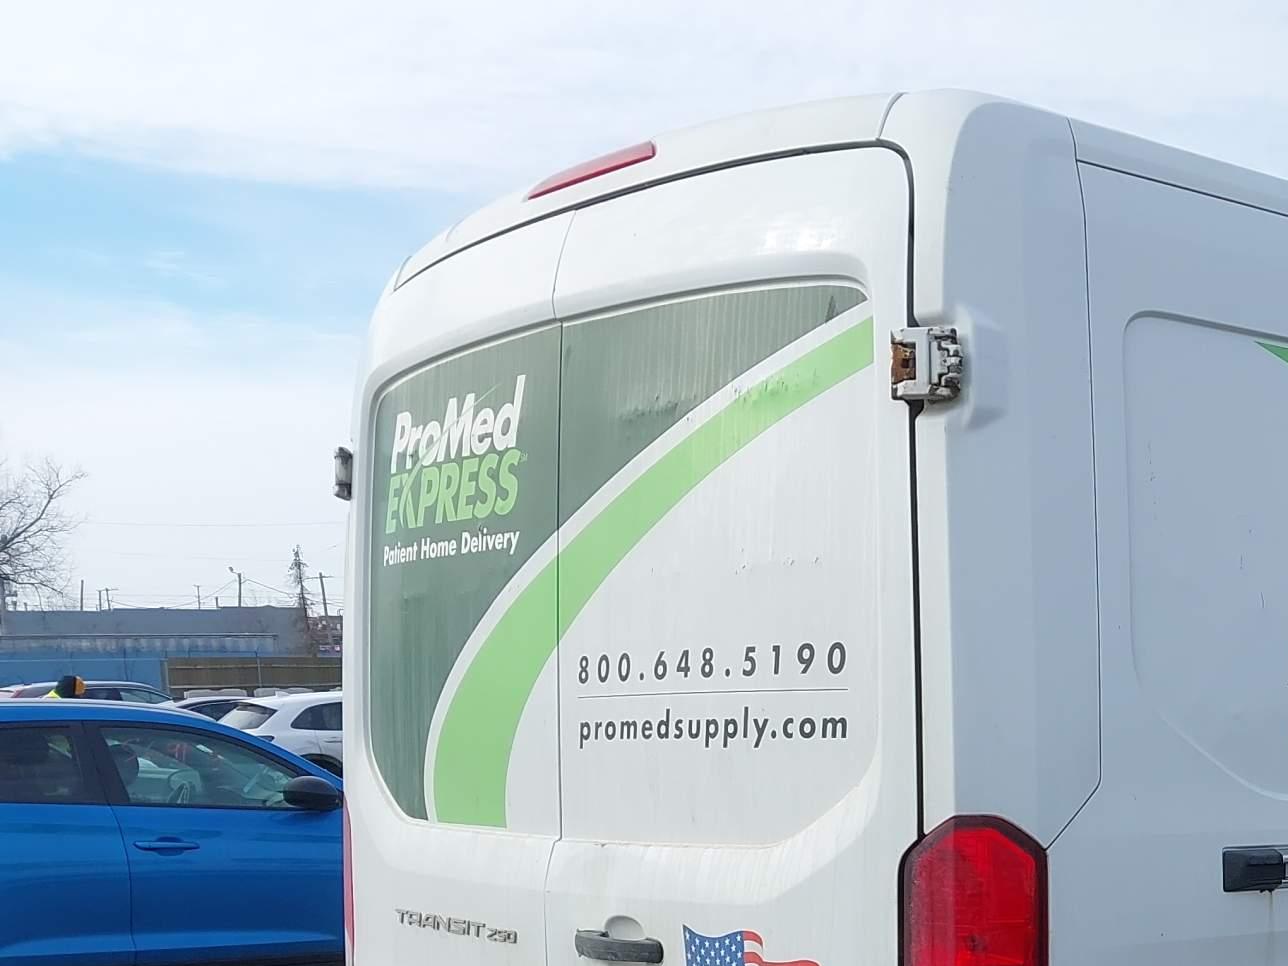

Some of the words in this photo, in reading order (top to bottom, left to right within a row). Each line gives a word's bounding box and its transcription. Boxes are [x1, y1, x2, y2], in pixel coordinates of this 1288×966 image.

[390, 374, 527, 474] ProMed
[385, 448, 522, 534] EXPRESS
[383, 542, 418, 566] Patient
[420, 537, 457, 560] Home
[461, 527, 520, 555] Delivery
[578, 641, 846, 684] 800.648.5190
[579, 706, 848, 749] promedsupply.com
[394, 908, 487, 938] TRANSIT
[486, 928, 518, 944] 250
